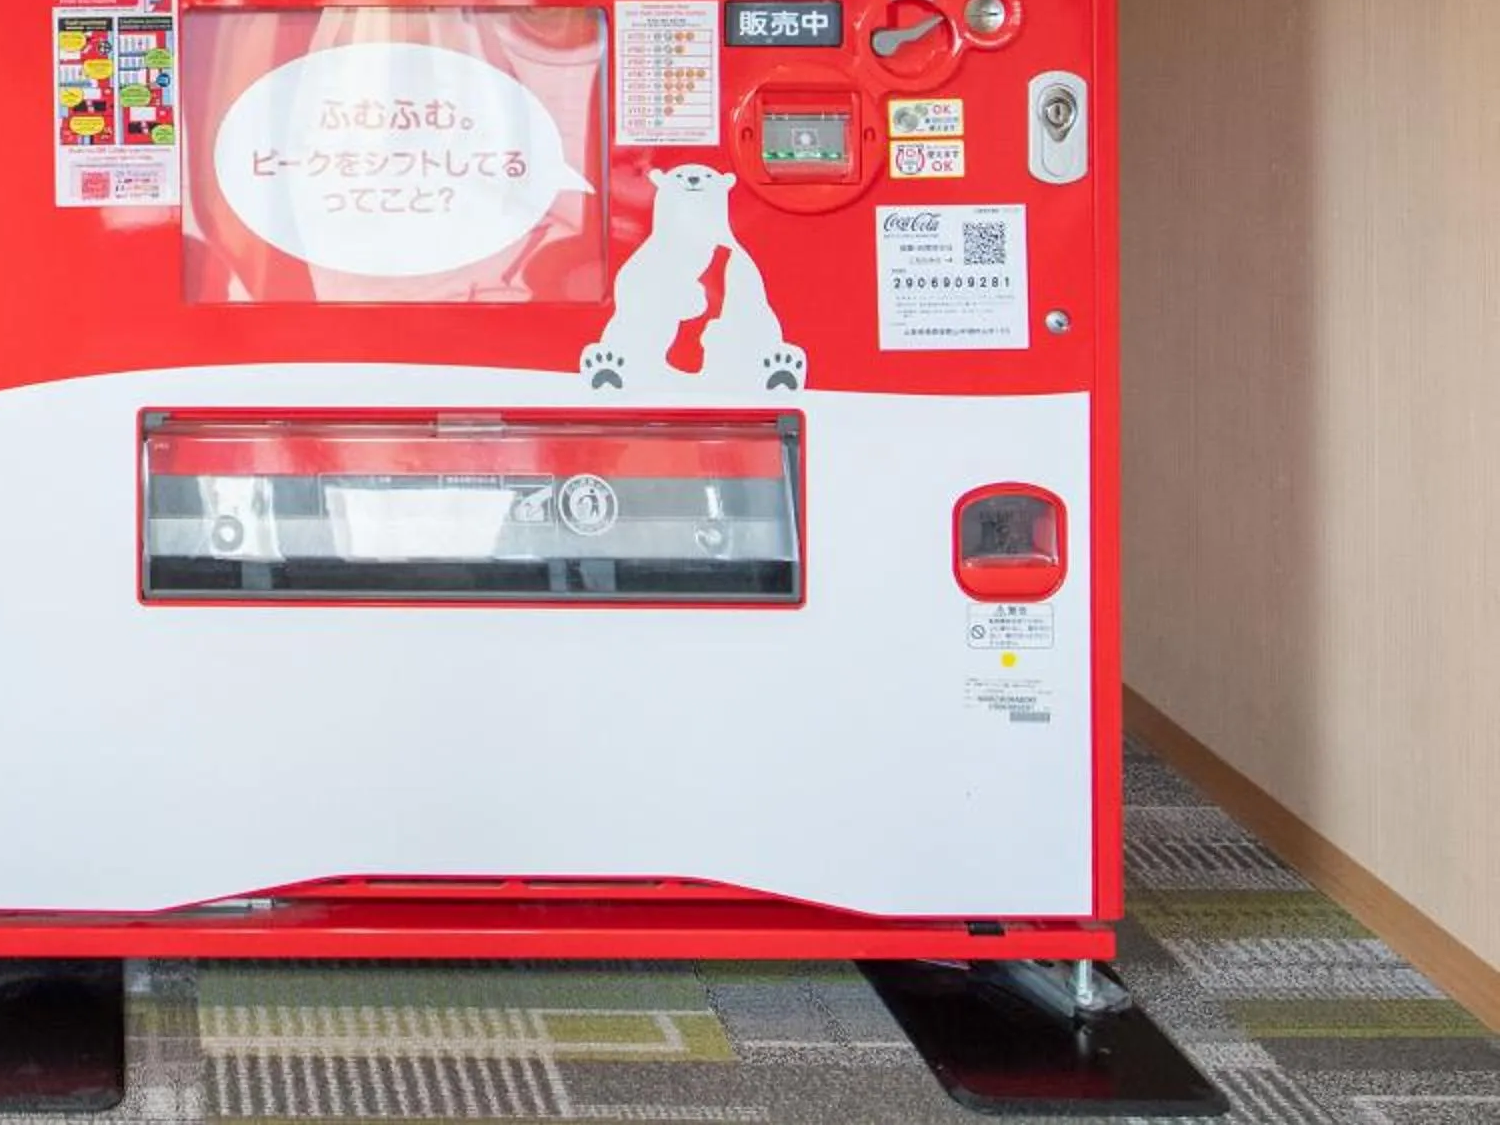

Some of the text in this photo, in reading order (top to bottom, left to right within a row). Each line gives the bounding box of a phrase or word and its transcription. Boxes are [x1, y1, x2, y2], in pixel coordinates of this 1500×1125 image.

[739, 10, 829, 37] 販売中
[320, 99, 476, 130] ふむふむ。
[933, 104, 952, 115] OK
[253, 149, 527, 179] ピークをシフトしてる
[931, 160, 954, 172] OK
[893, 276, 1010, 289] 2906909281
